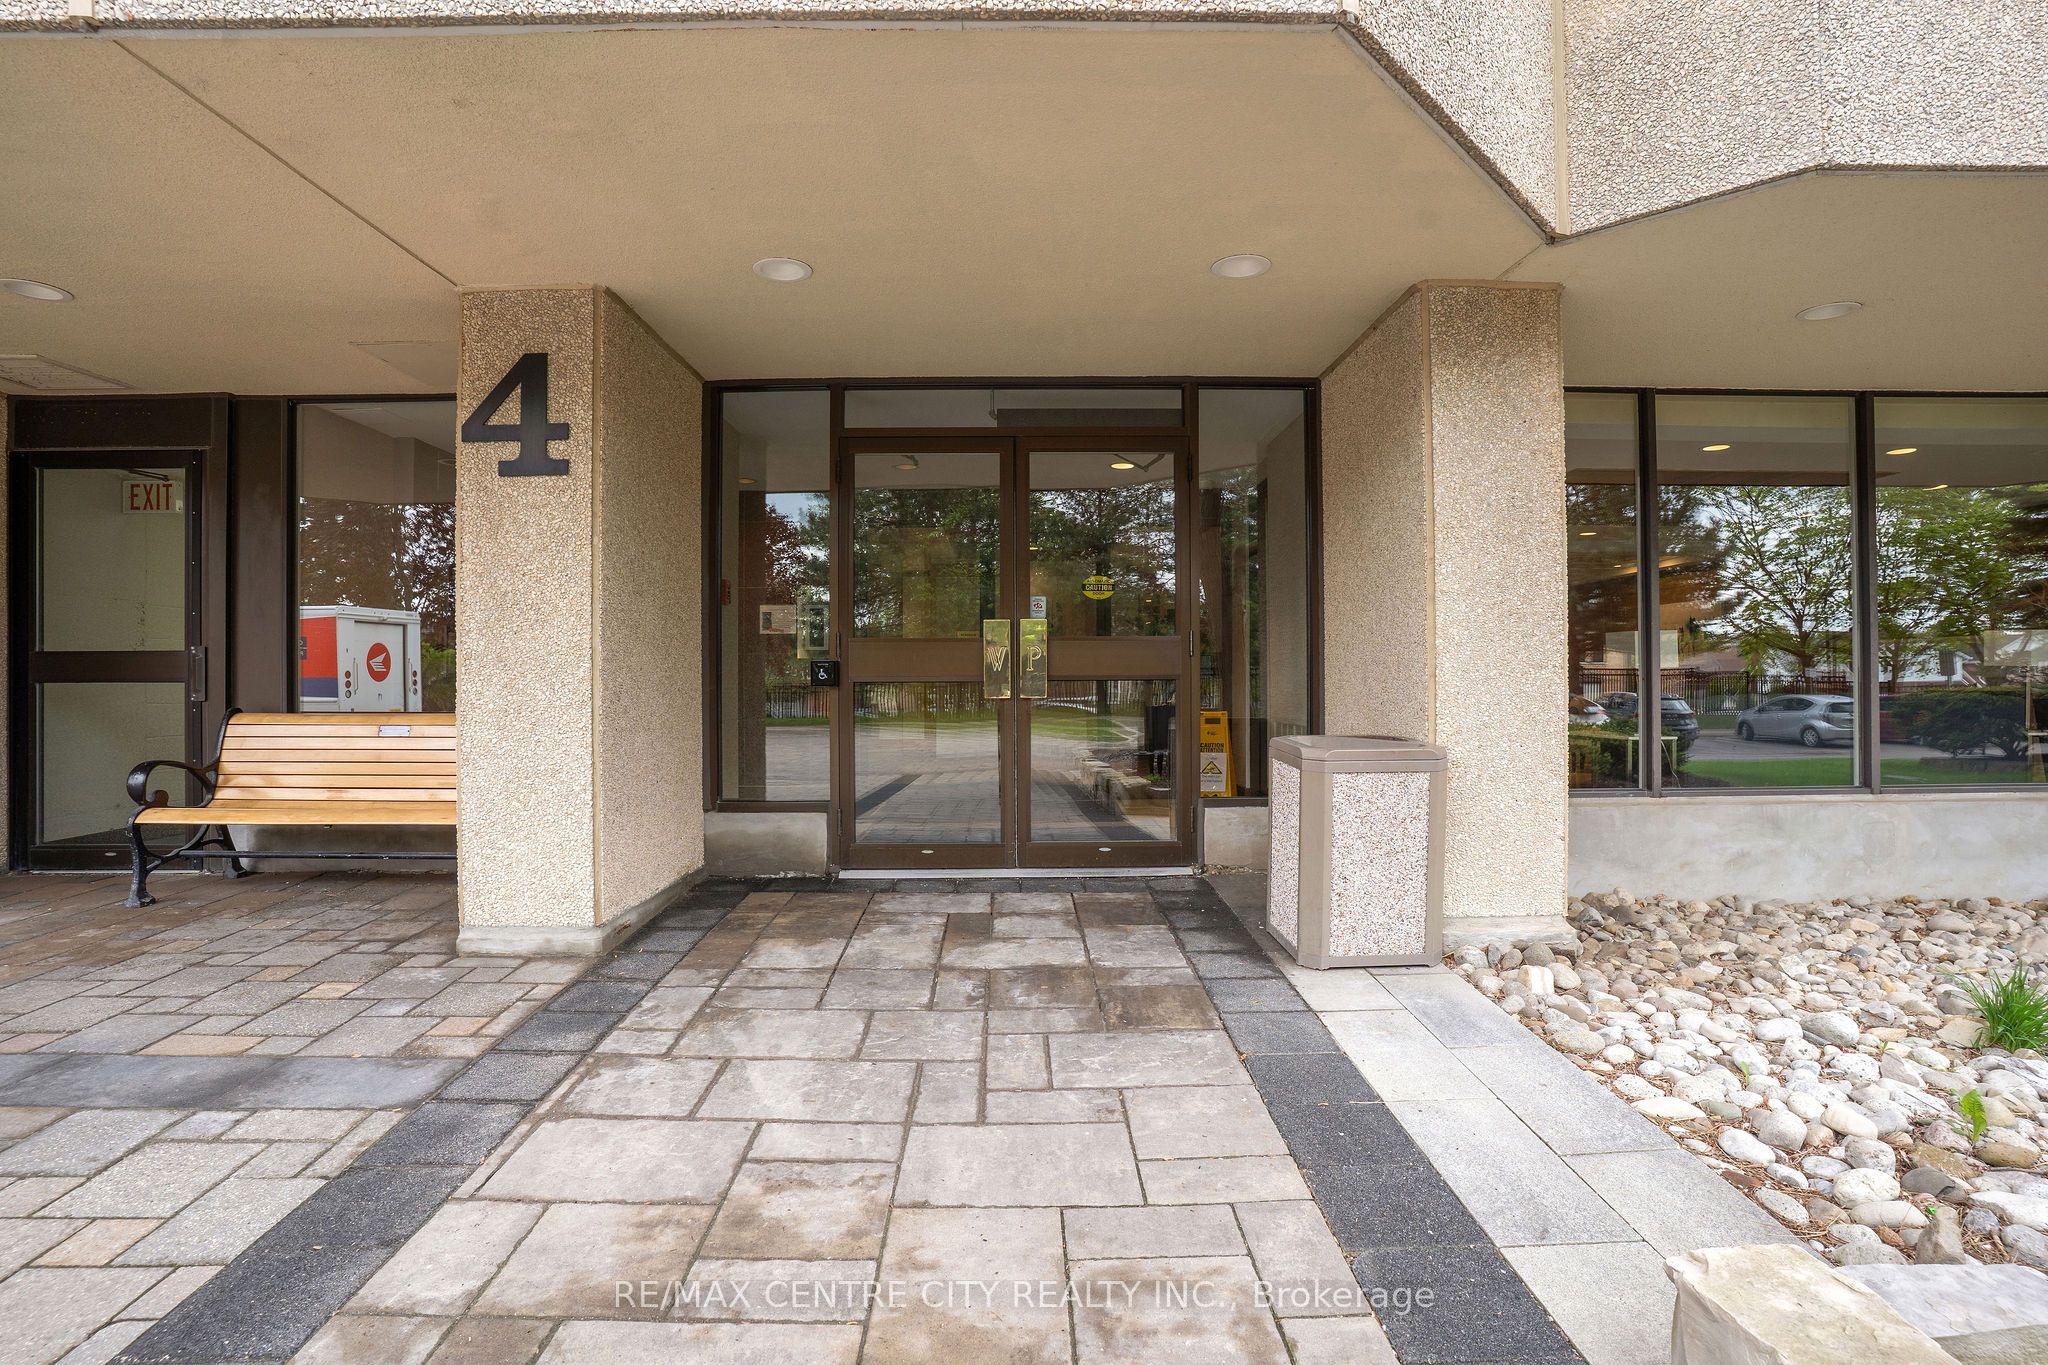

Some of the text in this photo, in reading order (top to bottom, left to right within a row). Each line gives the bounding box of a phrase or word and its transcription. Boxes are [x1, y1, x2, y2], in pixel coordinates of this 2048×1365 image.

[461, 352, 570, 477] 4
[130, 483, 173, 510] EXIT
[986, 646, 1008, 672] W
[1026, 645, 1042, 672] P
